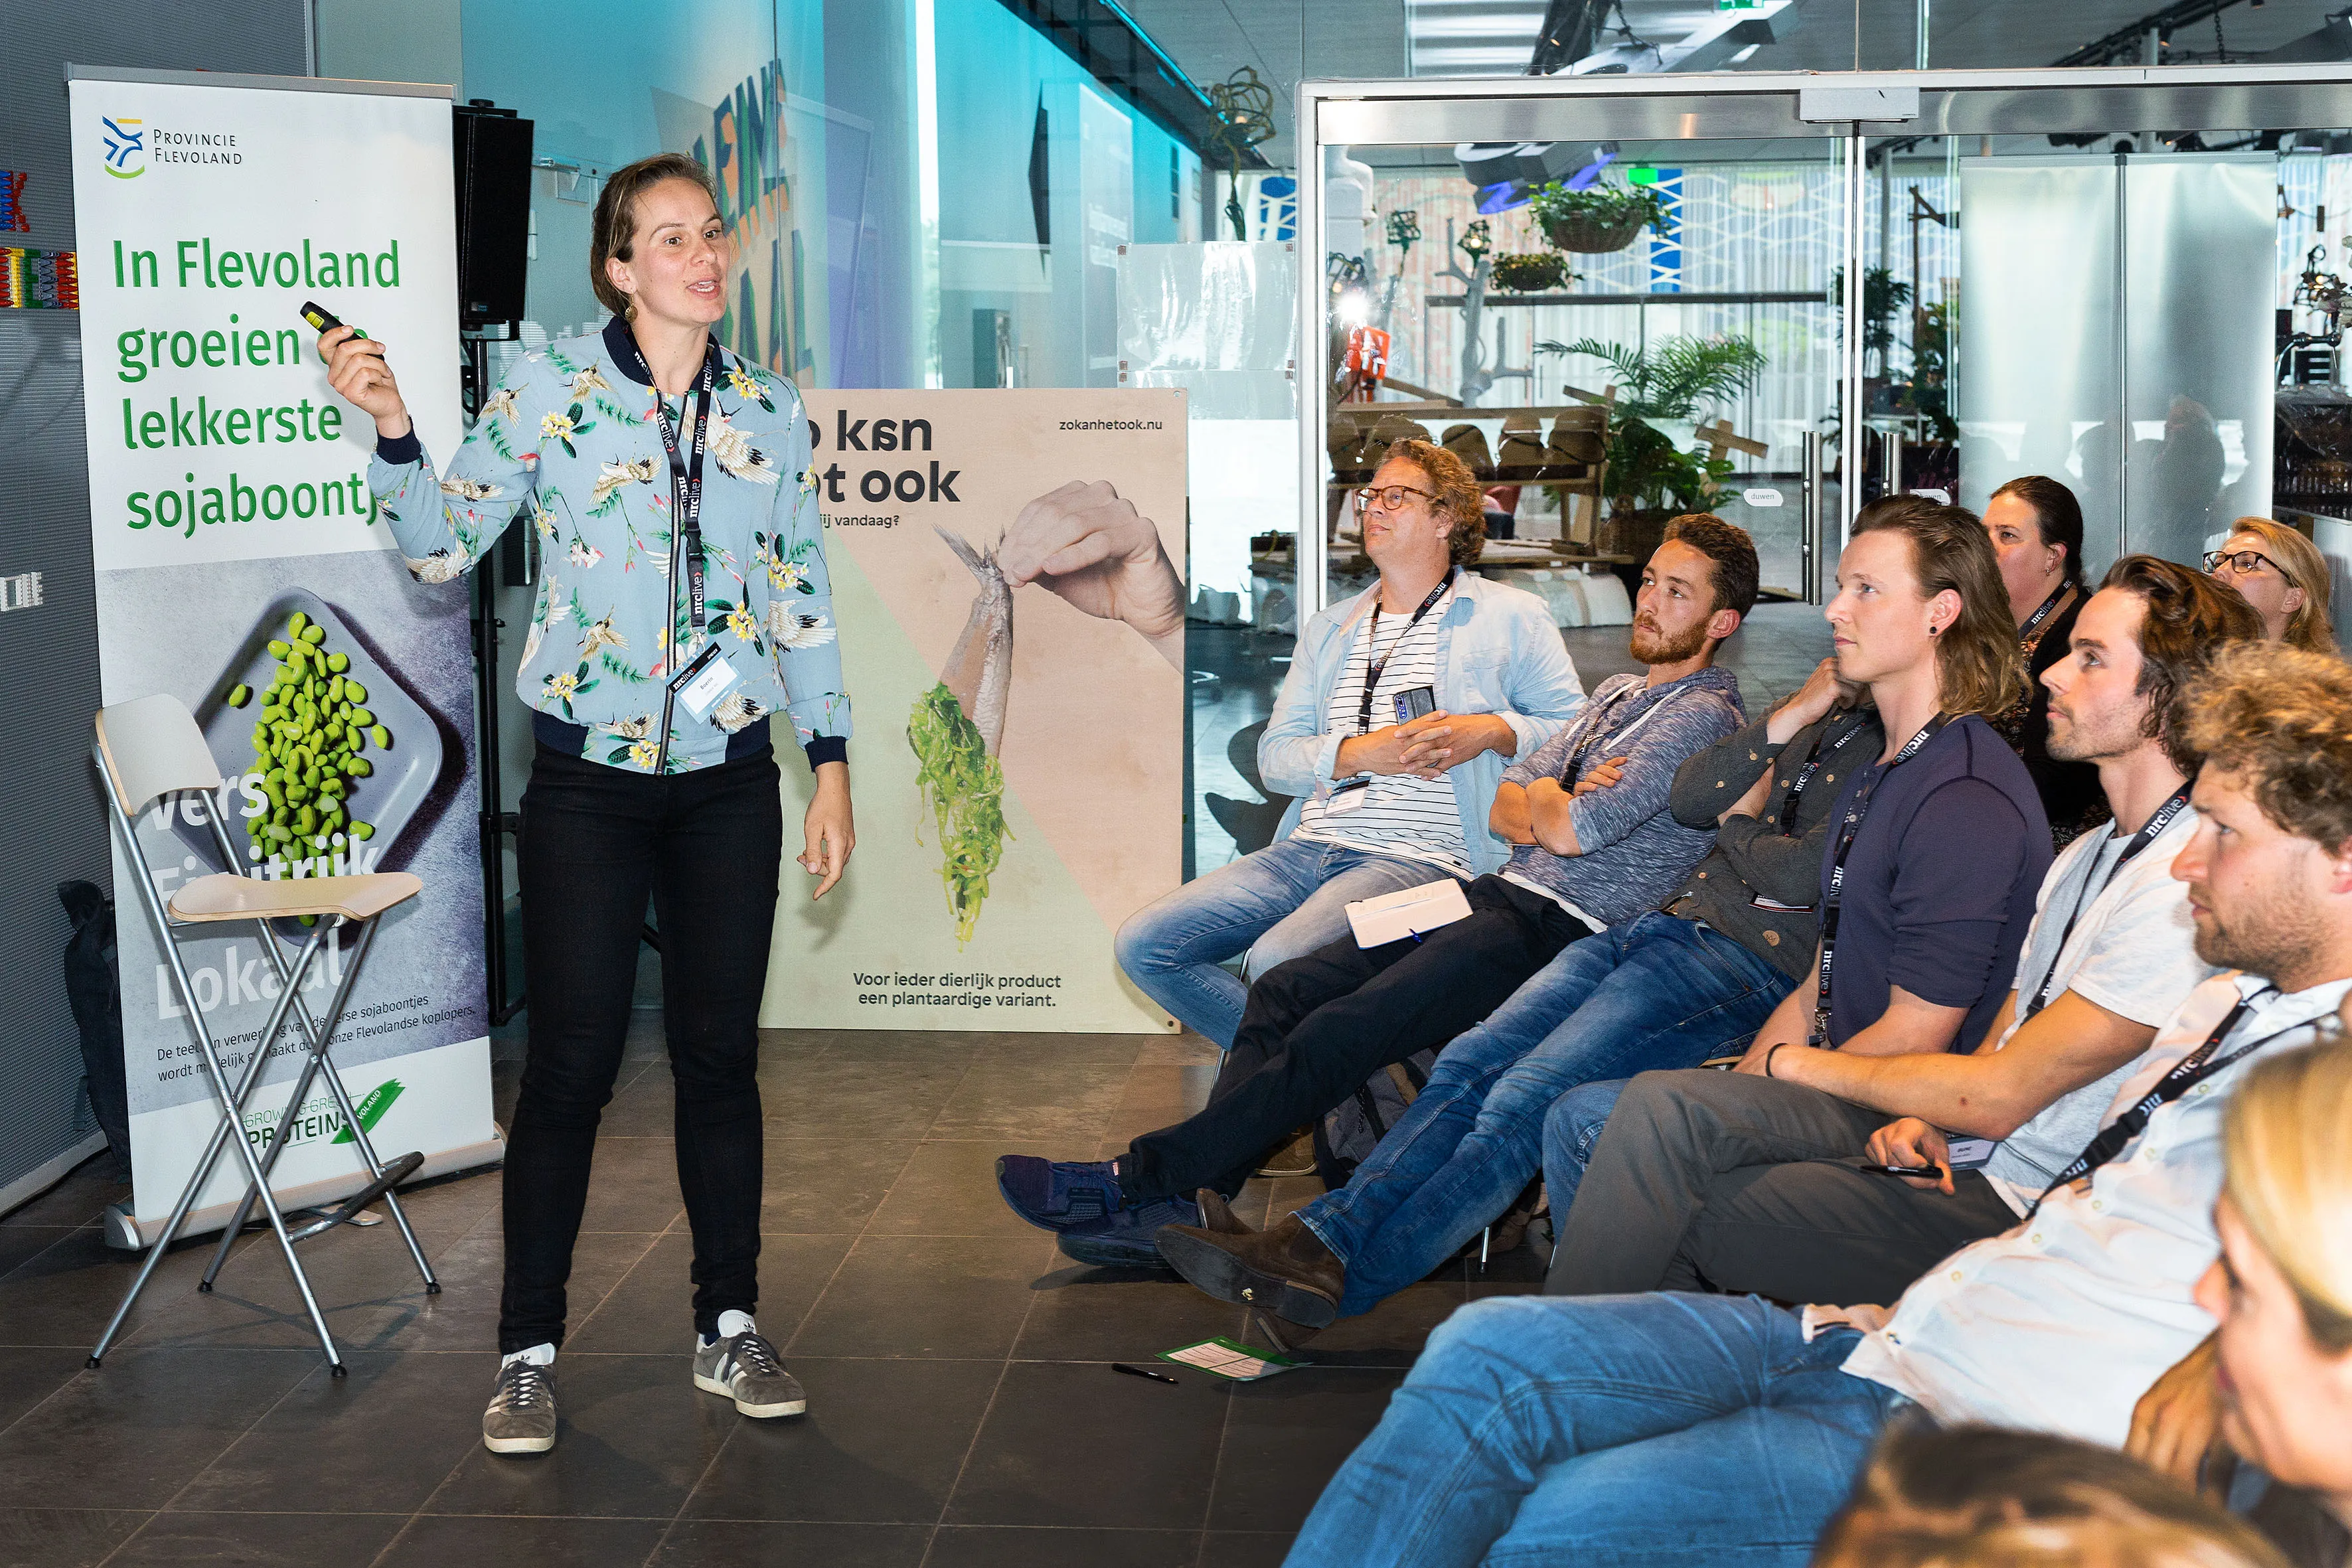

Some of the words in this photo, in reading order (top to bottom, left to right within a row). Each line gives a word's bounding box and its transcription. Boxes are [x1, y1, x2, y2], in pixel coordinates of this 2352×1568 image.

[153, 129, 236, 147] PROVINCIE
[155, 147, 242, 165] FLEVOLAND
[113, 240, 159, 287] In
[177, 237, 400, 288] Flevoland
[117, 313, 300, 383] groeien
[122, 395, 342, 449] lekkerste
[657, 411, 674, 449] nrclive
[695, 419, 706, 455] nrclive
[1059, 419, 1162, 430] zokanhetook.nu
[860, 461, 961, 503] ook
[689, 481, 701, 518] nrclive
[834, 515, 900, 529] vandaag?
[694, 576, 704, 615] nrclive
[1425, 582, 1448, 605] nrclive
[2031, 600, 2055, 625] nrclive
[672, 668, 695, 690] nrclive
[1834, 724, 1862, 749] nrclive
[1894, 730, 1930, 763] nrclive
[1794, 764, 1817, 793] nrclive
[2145, 799, 2184, 837] nrclive
[853, 973, 890, 986] Voor
[894, 972, 935, 986] ieder
[939, 972, 994, 990] dierlijk
[998, 975, 1061, 990] product
[1820, 951, 1833, 990] nrclive
[858, 993, 888, 1004] een
[892, 992, 992, 1009] plantaardige
[996, 993, 1056, 1007] variant.
[157, 1048, 173, 1061] De
[289, 1022, 303, 1034] va
[360, 994, 429, 1018] sojaboontjes
[158, 1063, 193, 1081] wordt
[328, 1031, 353, 1045] onze
[356, 1016, 418, 1039] Flevolandse
[422, 1005, 475, 1025] koplopers.
